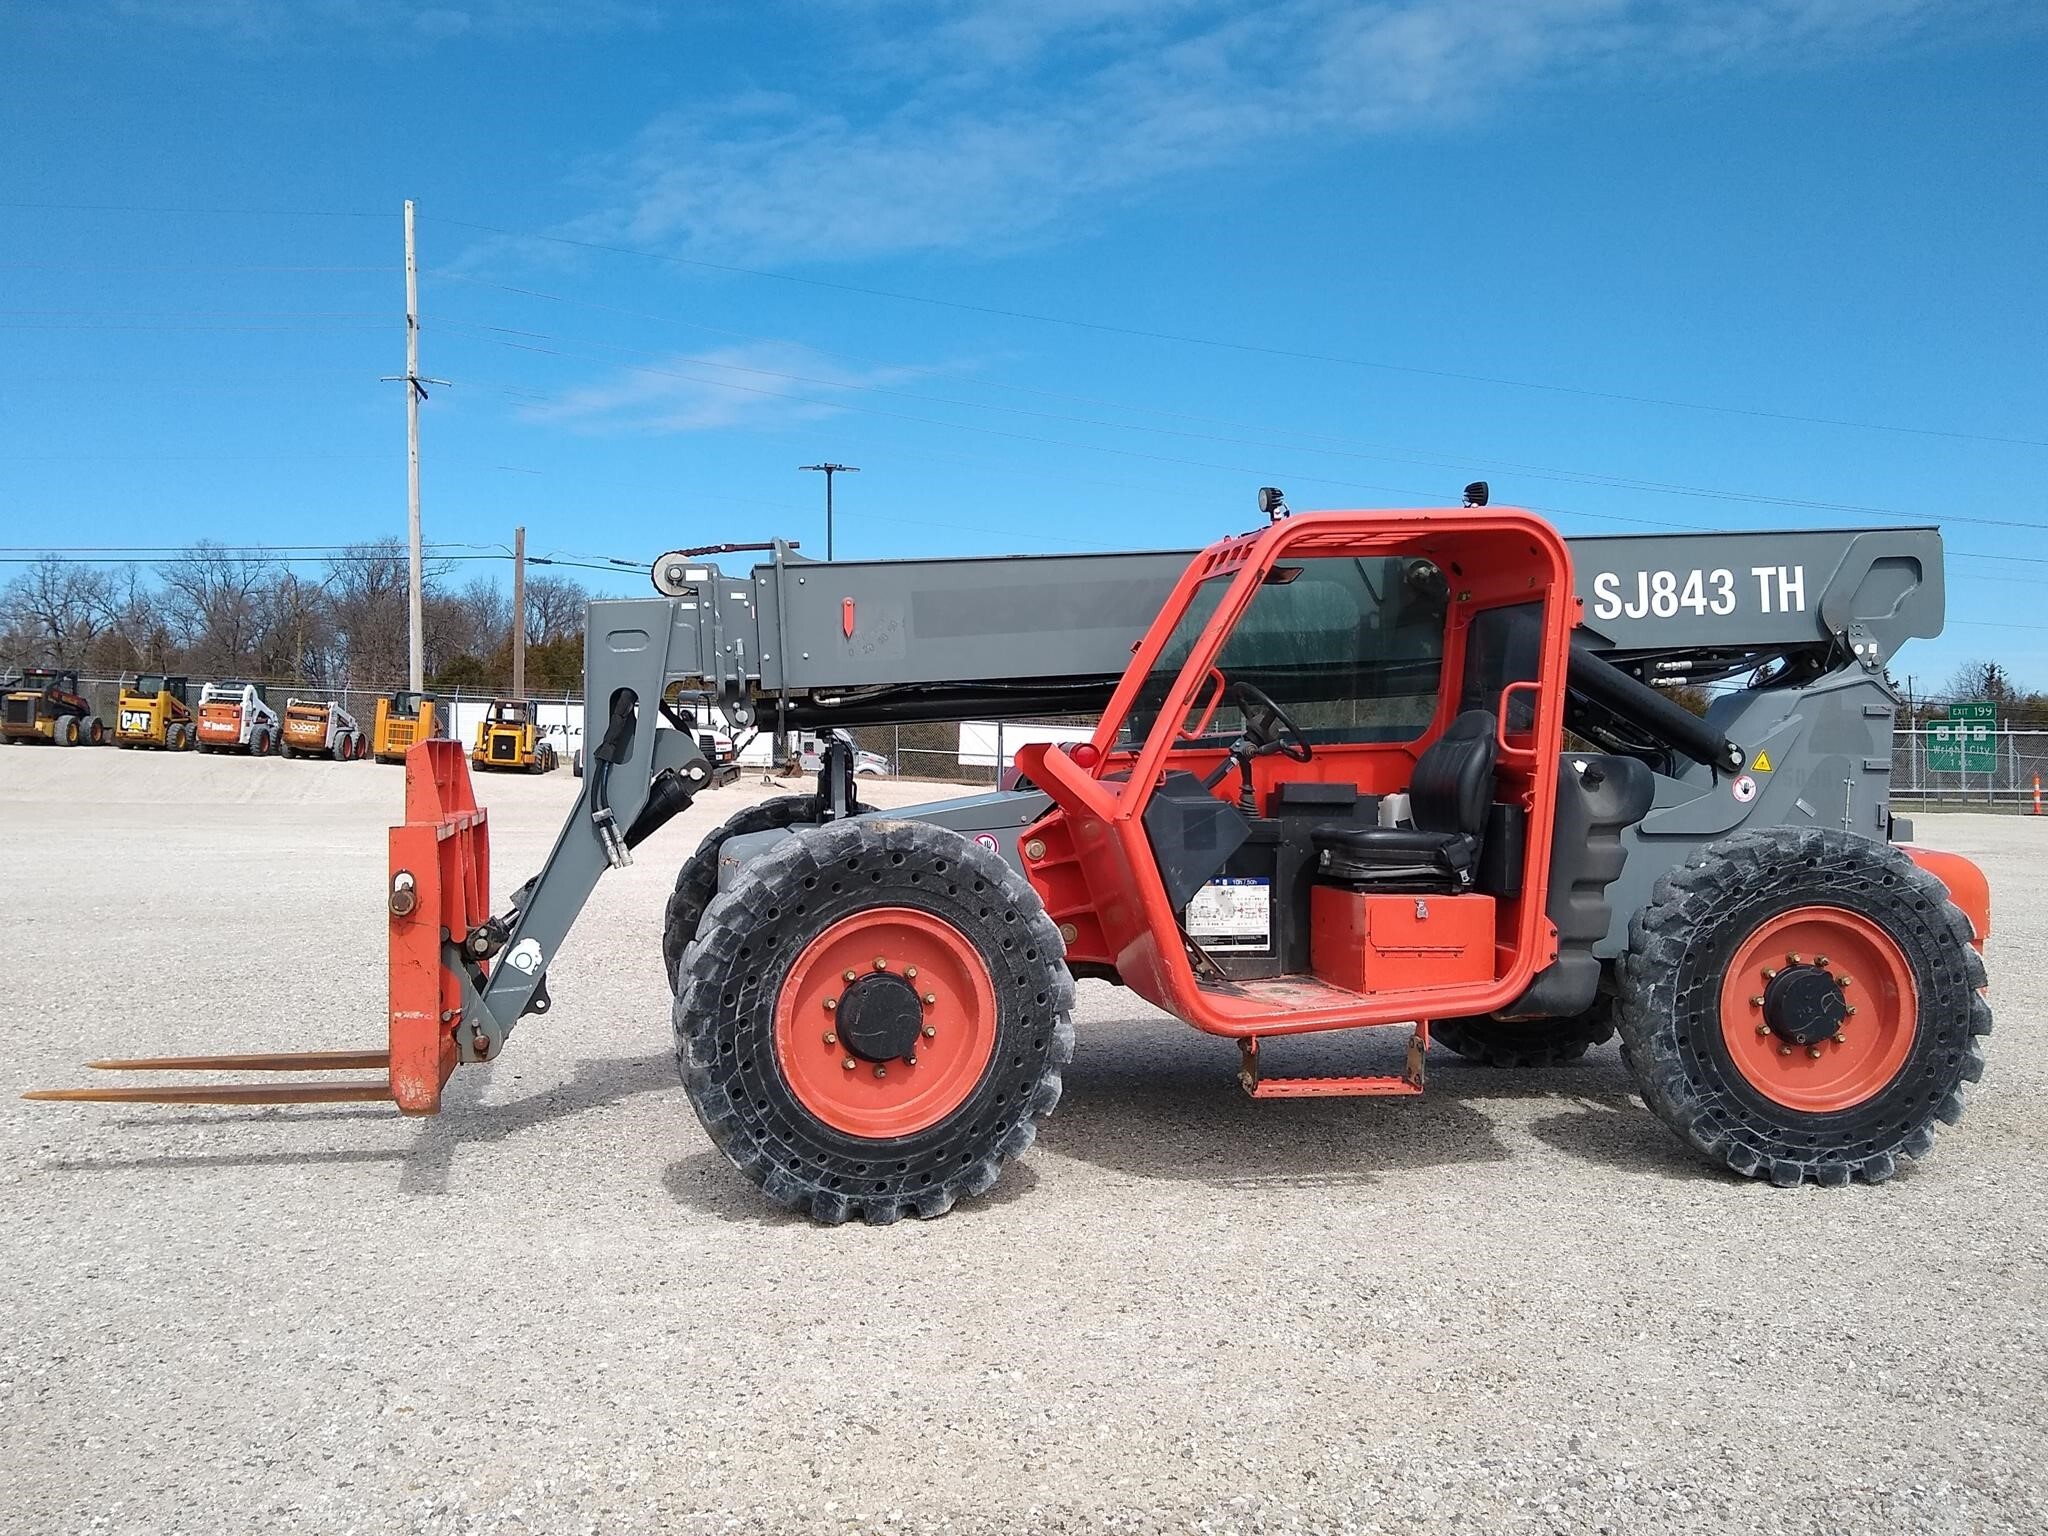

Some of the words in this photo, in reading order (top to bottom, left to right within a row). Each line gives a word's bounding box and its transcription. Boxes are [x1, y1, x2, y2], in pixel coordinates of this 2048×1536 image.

[1593, 568, 1736, 620] SJ843
[1751, 565, 1805, 613] TH
[1952, 708, 1968, 716] EXIT
[1974, 706, 1992, 717] 199
[121, 711, 150, 731] CAT
[1969, 745, 1991, 757] City
